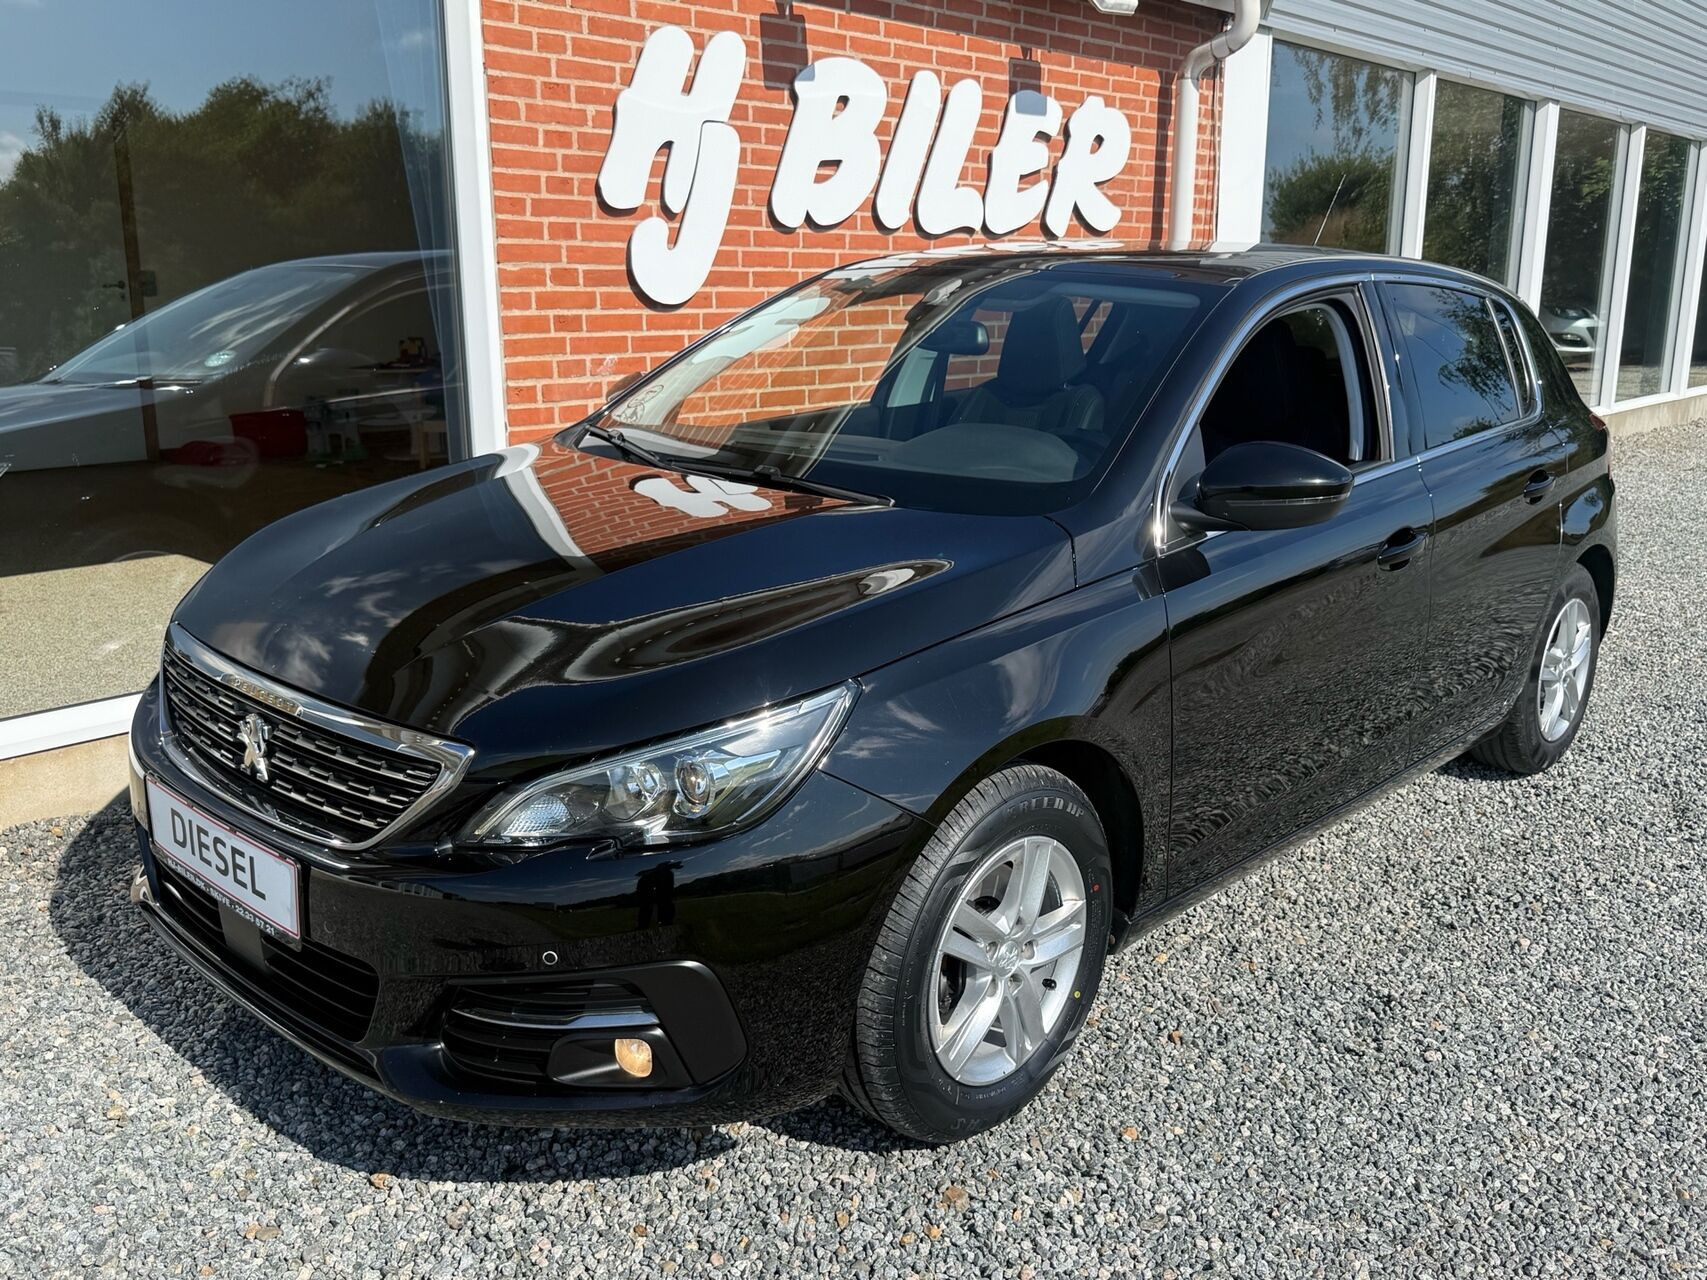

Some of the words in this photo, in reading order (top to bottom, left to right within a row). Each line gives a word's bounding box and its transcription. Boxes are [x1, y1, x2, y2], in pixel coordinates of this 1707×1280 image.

[598, 25, 746, 305] HJ
[772, 57, 1132, 238] BILER
[171, 807, 266, 901] DIESEL
